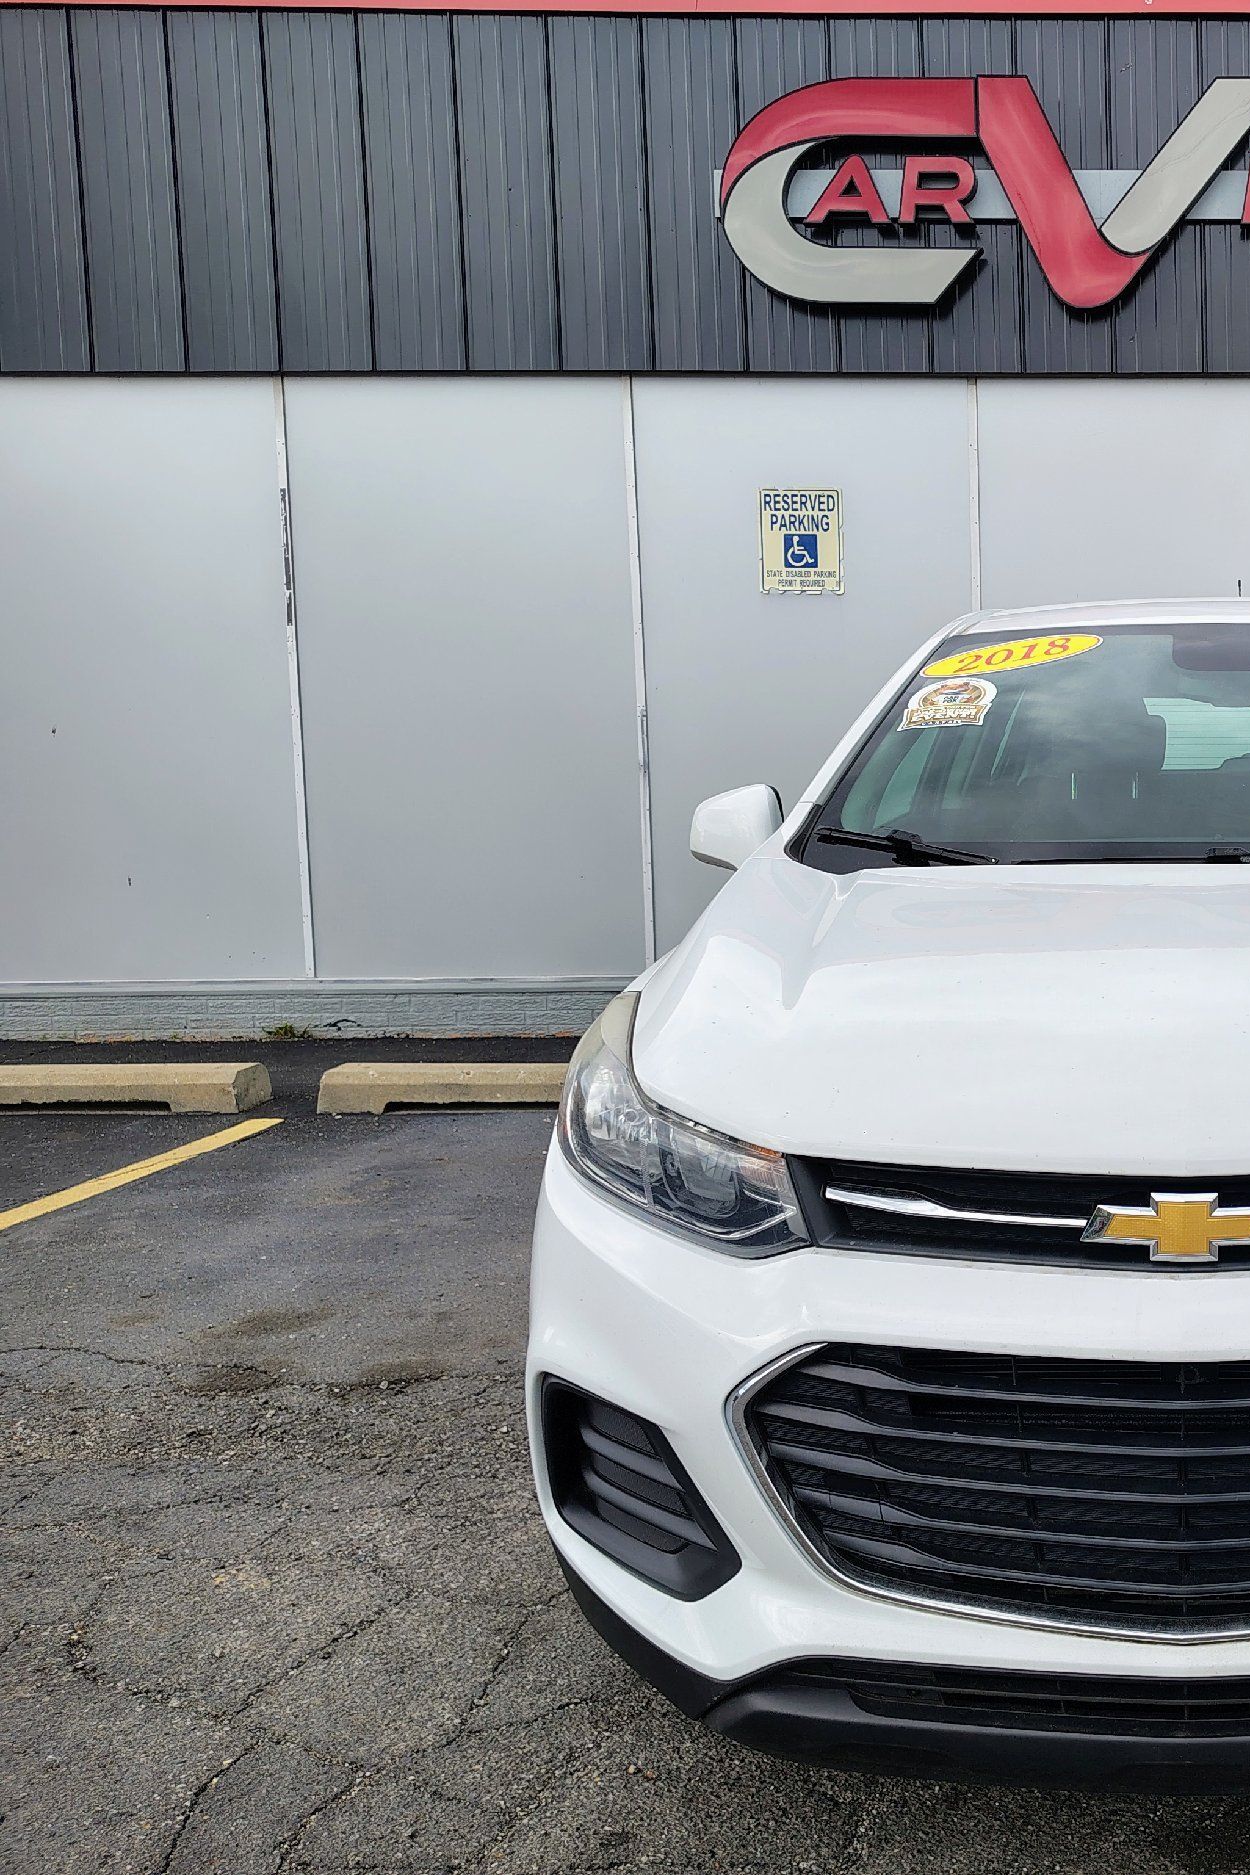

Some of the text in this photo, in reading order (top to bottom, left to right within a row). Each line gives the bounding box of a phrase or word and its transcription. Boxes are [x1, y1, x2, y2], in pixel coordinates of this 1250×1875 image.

[763, 493, 836, 512] RESERVED
[770, 514, 830, 532] PARKING
[766, 570, 837, 578] STATE DISABLED PARKING
[777, 579, 826, 587] PERMIT REQUIRED
[952, 637, 1072, 674] 2018
